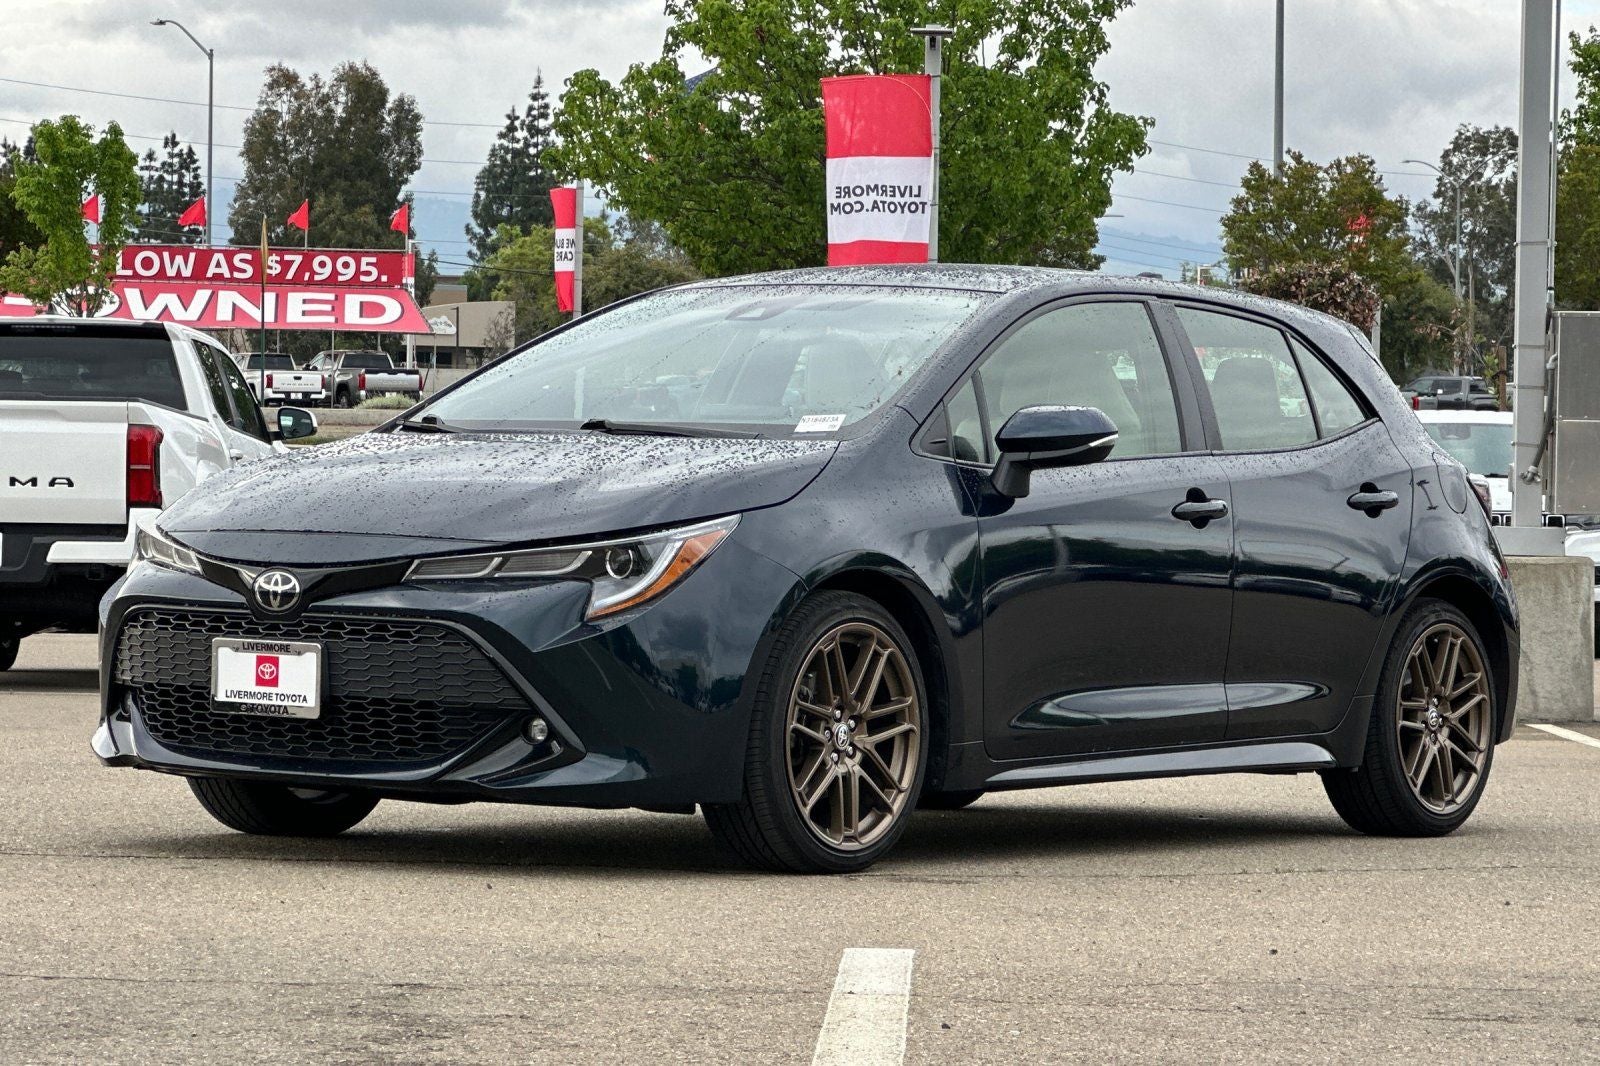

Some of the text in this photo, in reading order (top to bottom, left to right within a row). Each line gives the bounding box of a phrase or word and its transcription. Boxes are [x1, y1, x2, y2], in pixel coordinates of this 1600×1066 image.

[115, 251, 196, 278] LOW
[206, 252, 253, 279] AS
[266, 253, 388, 282] $7,995.
[242, 642, 291, 653] LIVERMORE
[225, 689, 308, 703] LIVERMORE TOYOTA
[250, 703, 289, 715] TOYOTA
